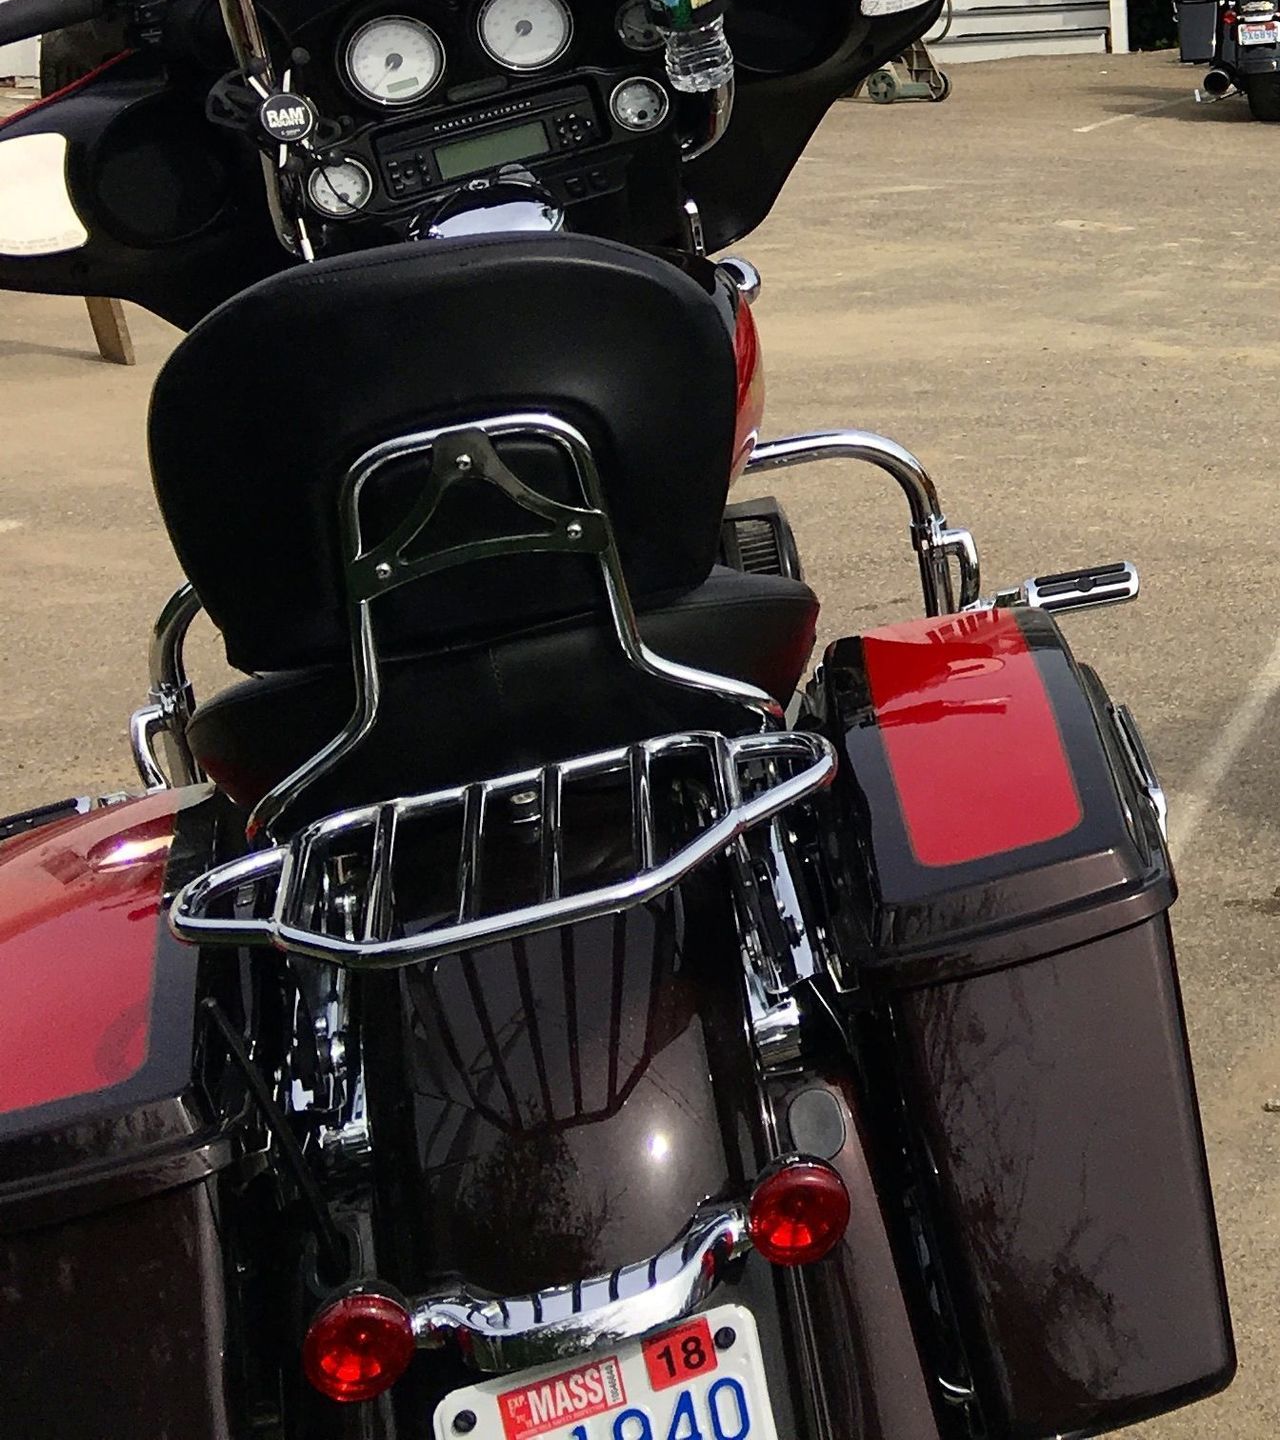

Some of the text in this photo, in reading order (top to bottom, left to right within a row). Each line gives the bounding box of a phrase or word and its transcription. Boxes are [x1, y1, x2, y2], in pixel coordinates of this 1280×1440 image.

[265, 106, 304, 122] RAM
[656, 1335, 707, 1379] 18
[526, 1367, 604, 1425] MASS
